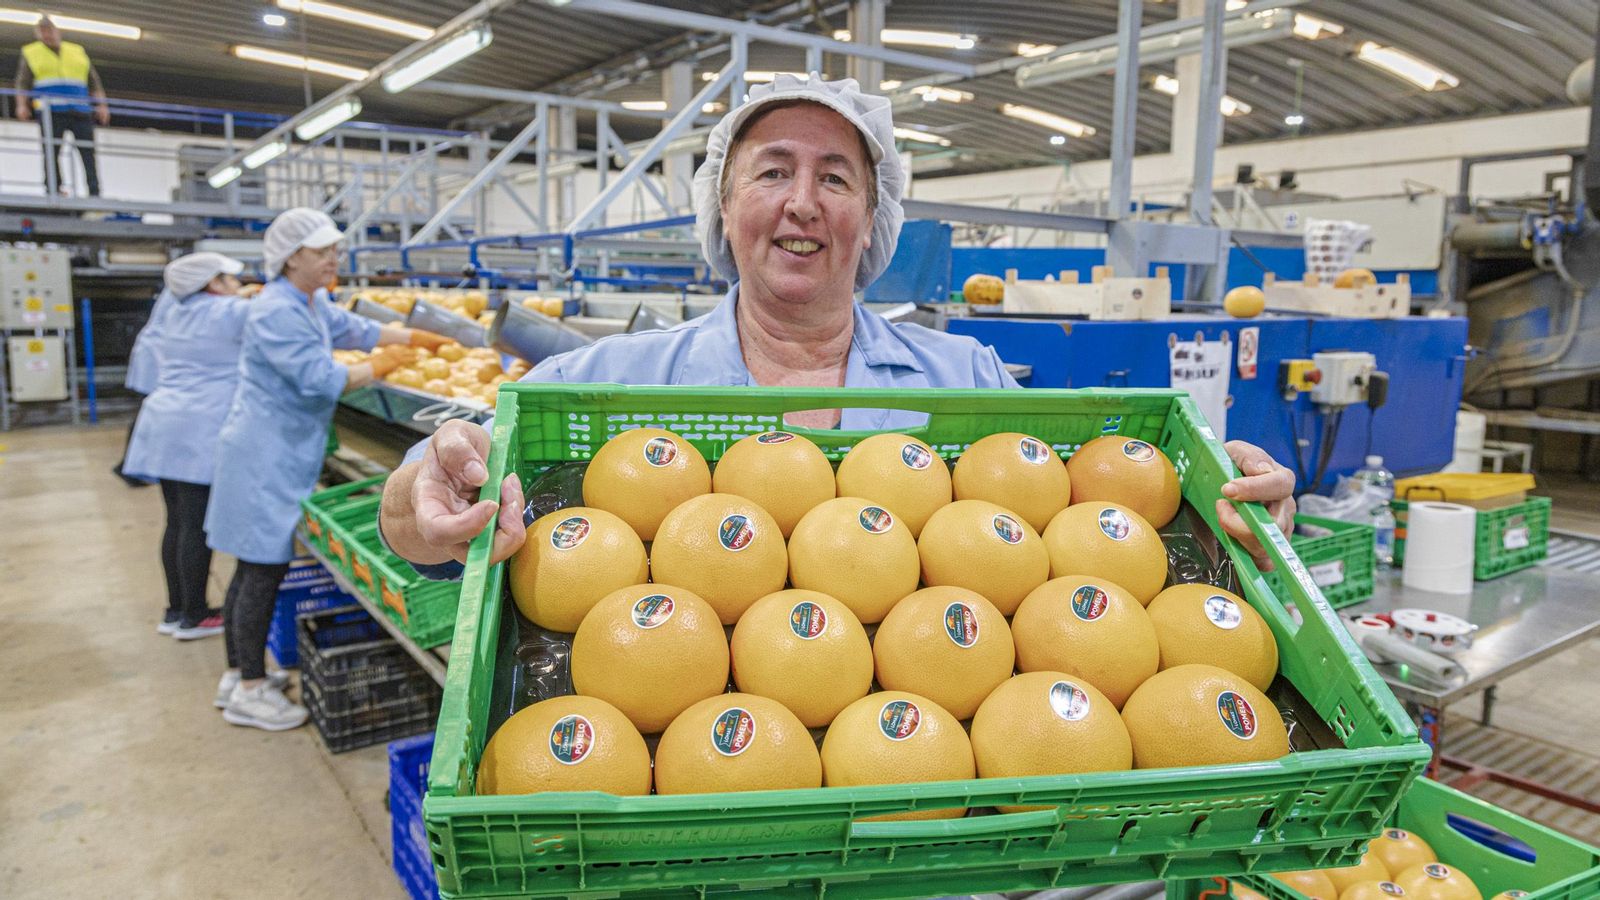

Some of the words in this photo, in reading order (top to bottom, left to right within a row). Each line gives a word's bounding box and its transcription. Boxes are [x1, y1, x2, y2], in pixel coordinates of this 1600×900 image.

[733, 524, 751, 547] POMELO
[1090, 592, 1104, 616] POMELO
[812, 608, 821, 633] POMELO
[963, 610, 974, 640] POMELO
[901, 707, 915, 734] POMELO
[1236, 699, 1251, 731] POMELO
[574, 723, 586, 755] POMELO
[723, 727, 732, 743] LOMAS
[734, 717, 749, 748] POMELO
